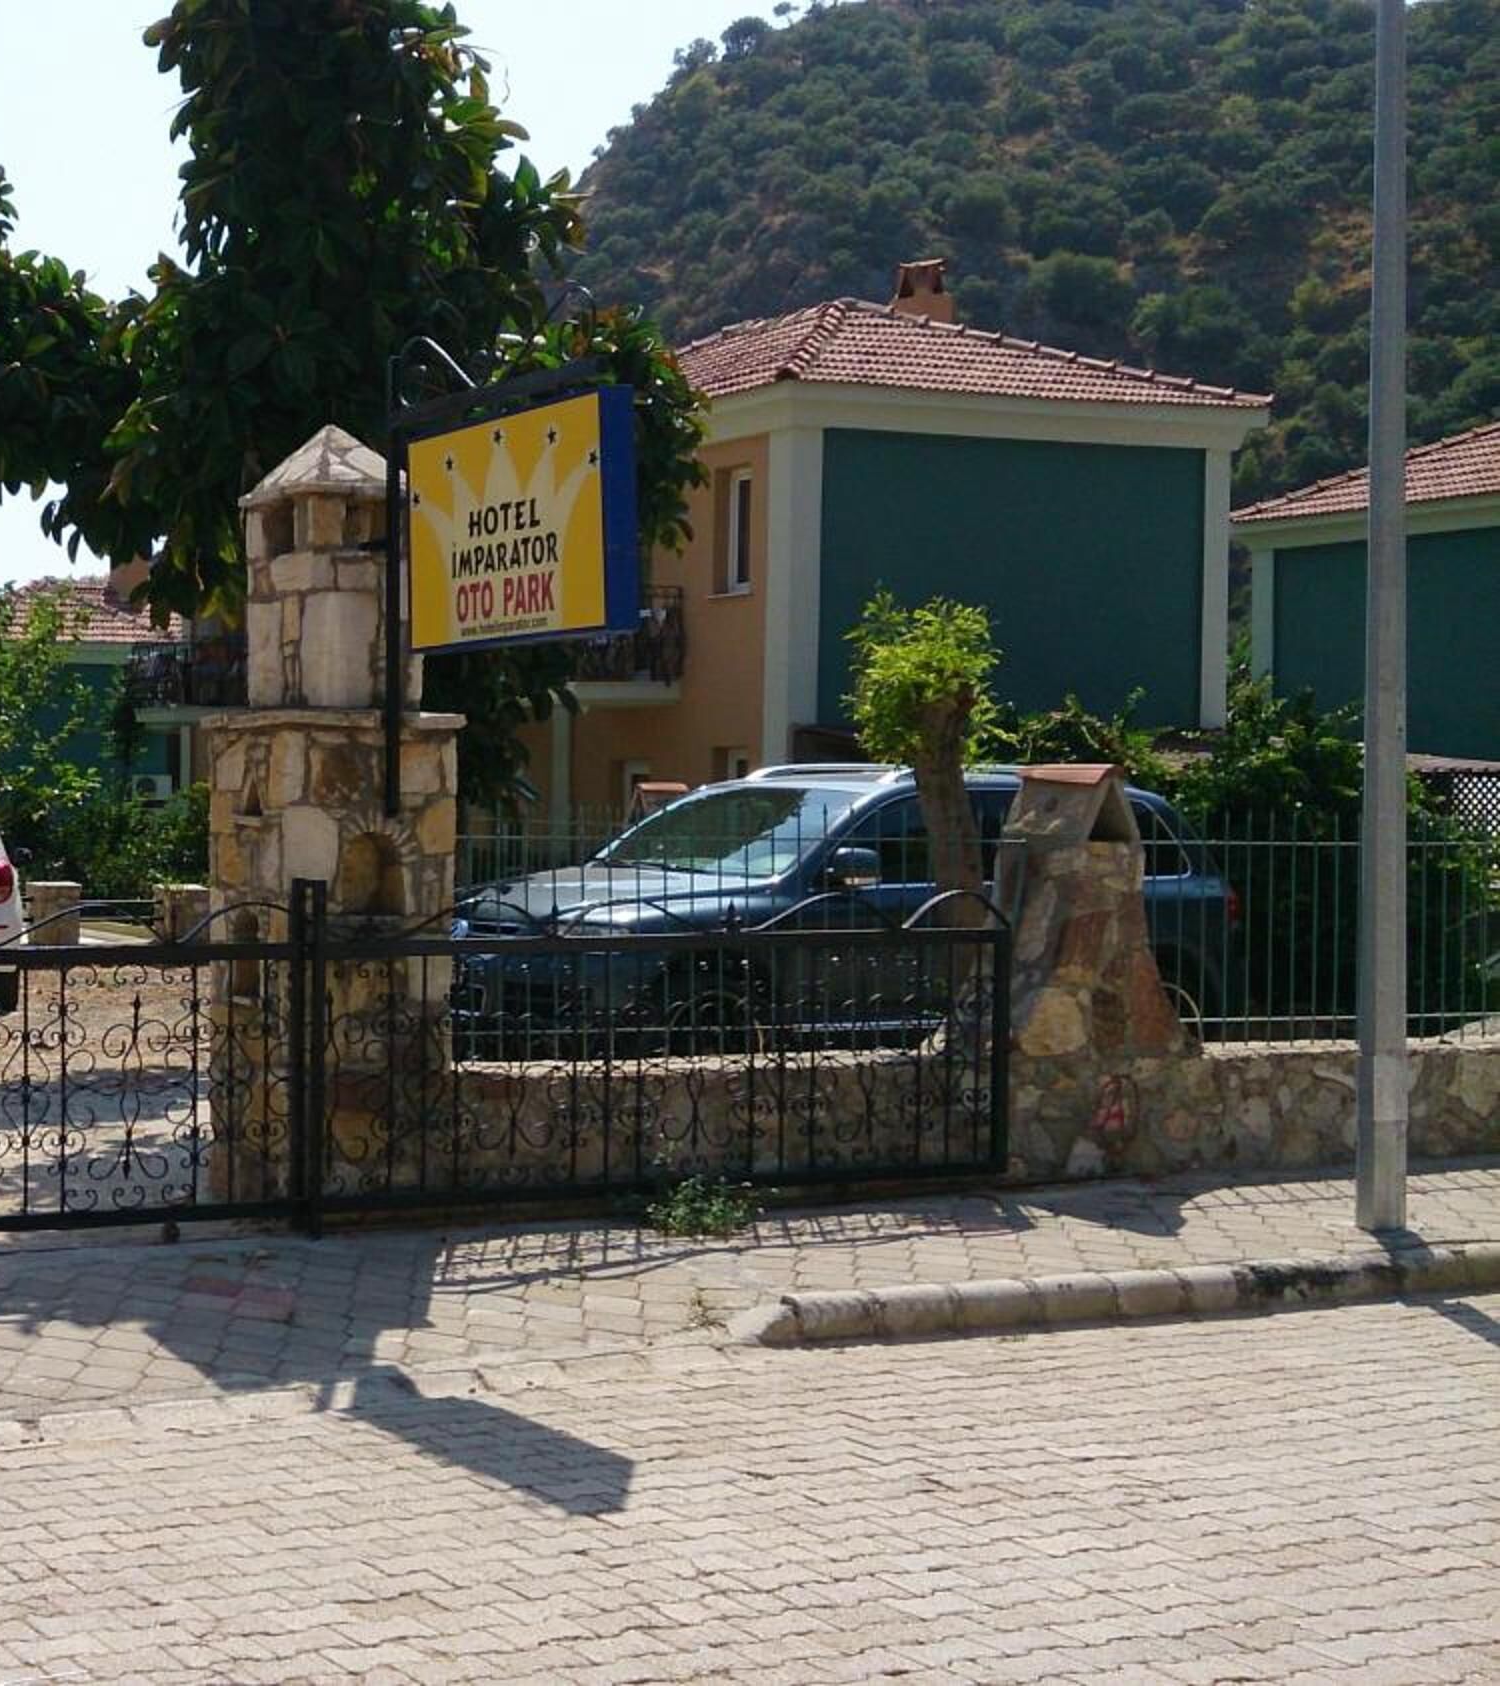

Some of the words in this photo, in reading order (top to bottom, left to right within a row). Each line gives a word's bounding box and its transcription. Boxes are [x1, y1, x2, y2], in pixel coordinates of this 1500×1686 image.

[468, 498, 540, 537] HOTEL
[452, 532, 559, 579] İMPARATOR
[456, 581, 494, 624] OTO
[503, 571, 555, 616] PARK
